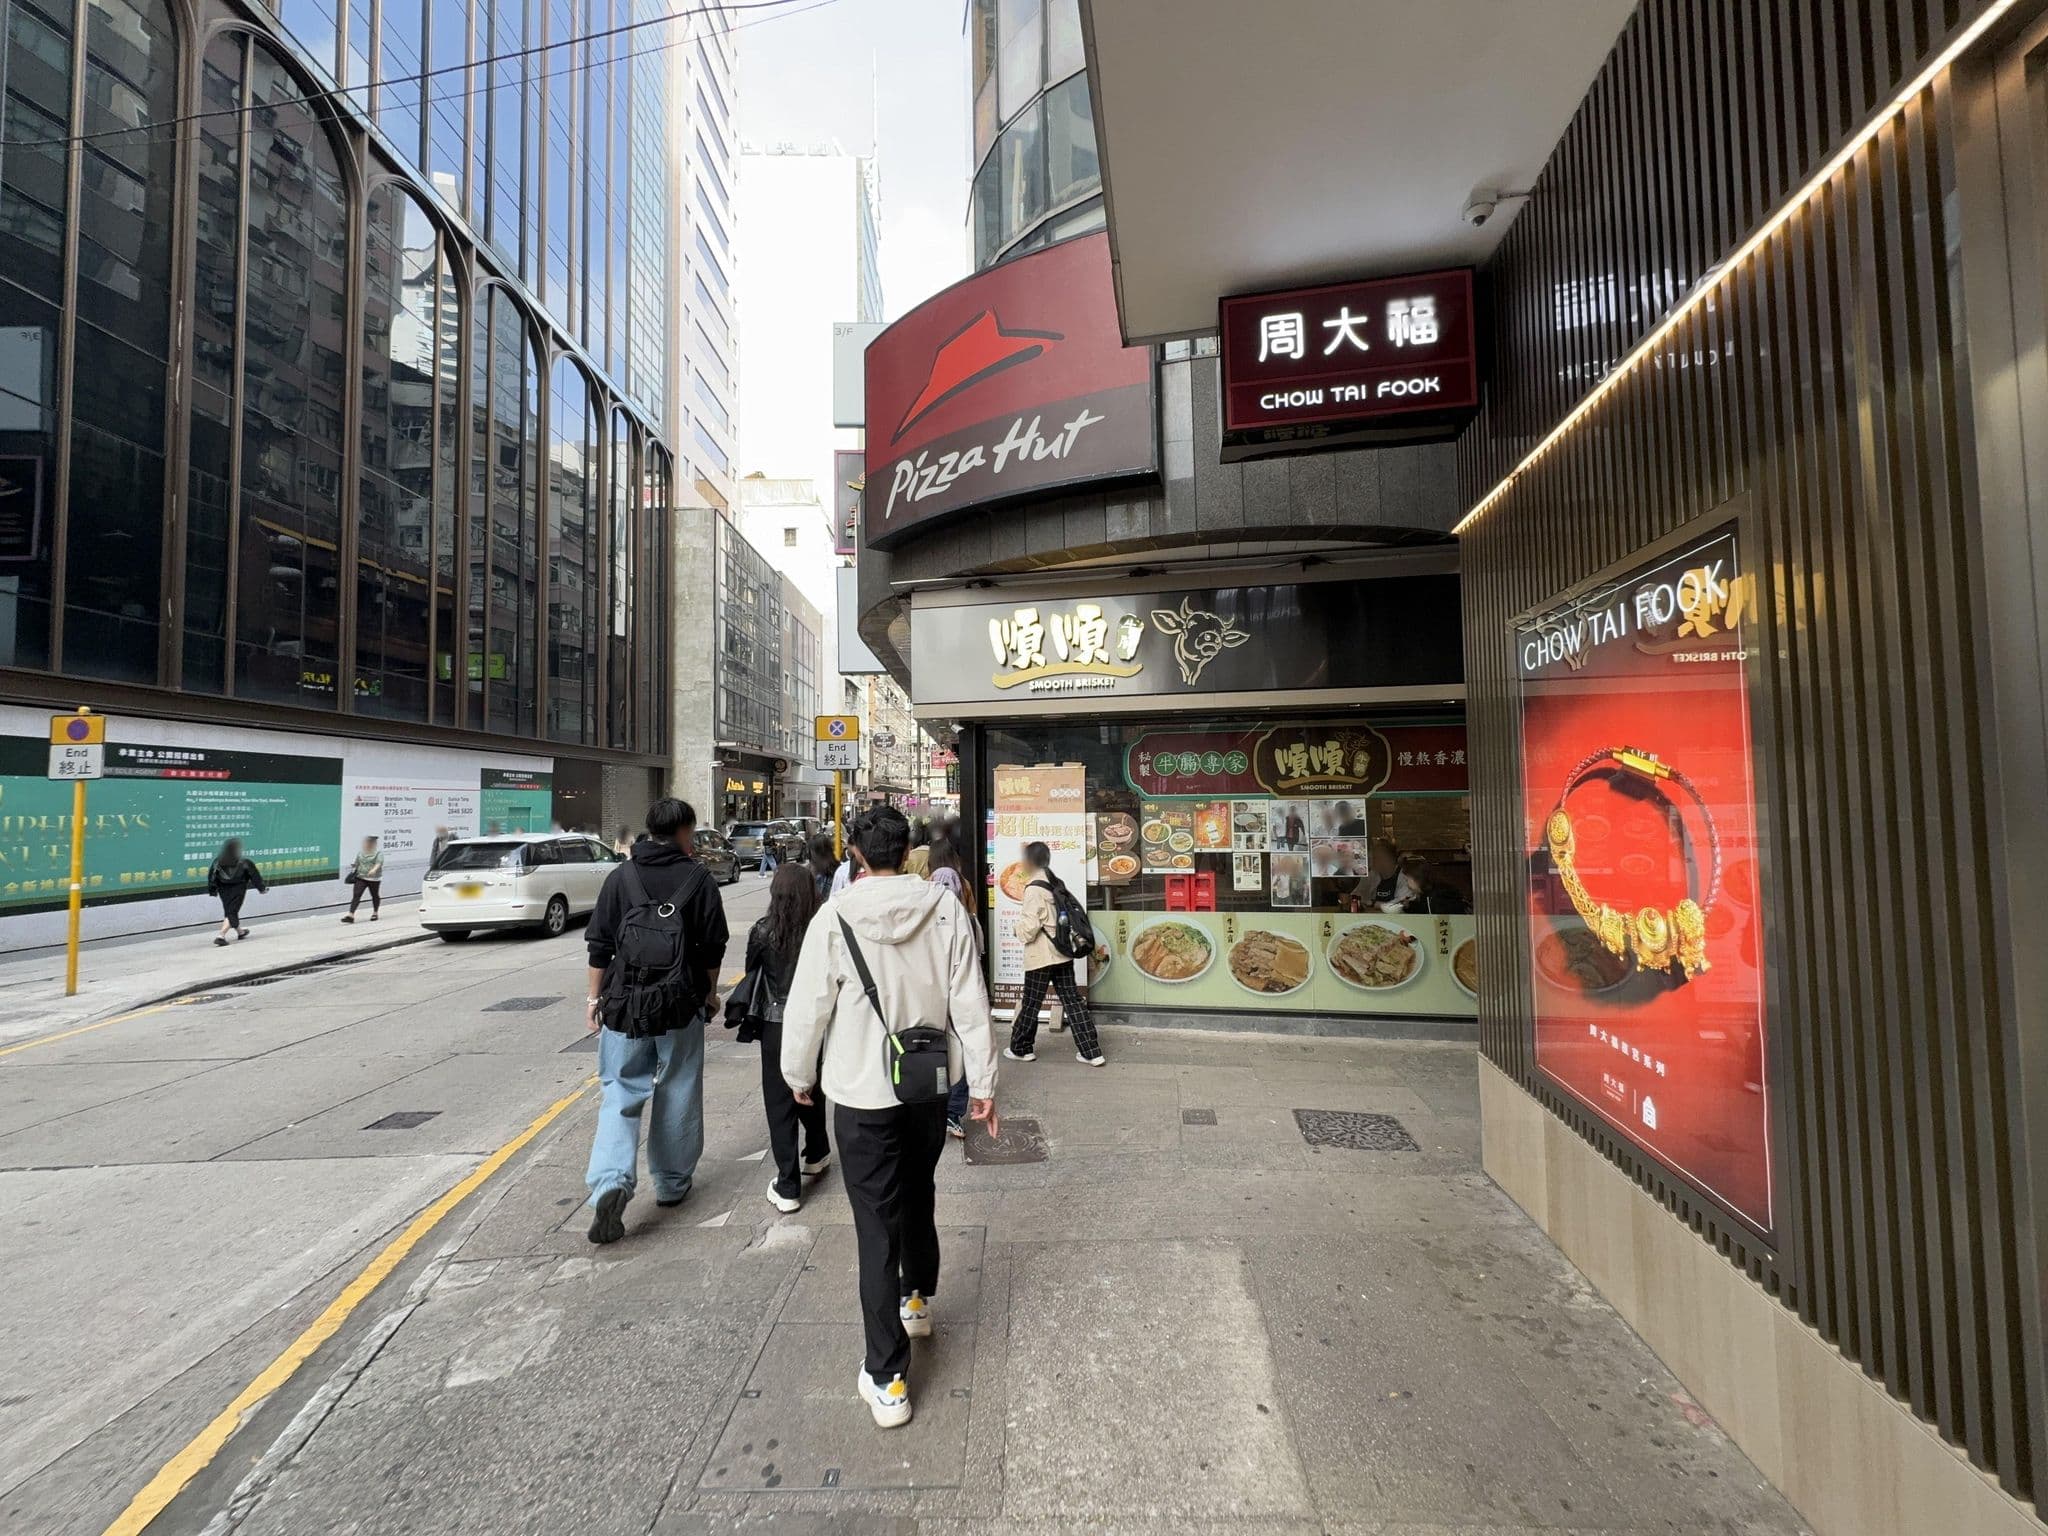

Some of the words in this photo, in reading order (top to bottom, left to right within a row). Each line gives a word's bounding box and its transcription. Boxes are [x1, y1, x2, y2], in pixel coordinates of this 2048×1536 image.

[1258, 297, 1439, 362] 周大福
[1259, 387, 1324, 410] CHOW
[1333, 383, 1367, 402] TAI
[1377, 376, 1440, 397] FOOK
[886, 445, 988, 519] Pizza
[994, 409, 1104, 474] Hut
[1524, 623, 1583, 672] CHOW
[1588, 602, 1627, 646] TAI
[1636, 559, 1727, 630] FOOK
[988, 603, 1110, 669] 順順
[1028, 678, 1073, 691] SMOOTH
[1076, 677, 1115, 688] BRISKET
[66, 748, 88, 758] End
[828, 743, 846, 752] End
[823, 753, 850, 766] 終止
[1156, 754, 1245, 772] 牛腩專家
[1274, 740, 1346, 778] 順順
[1397, 750, 1467, 766] 慢熬香濃
[59, 761, 92, 776] 終止
